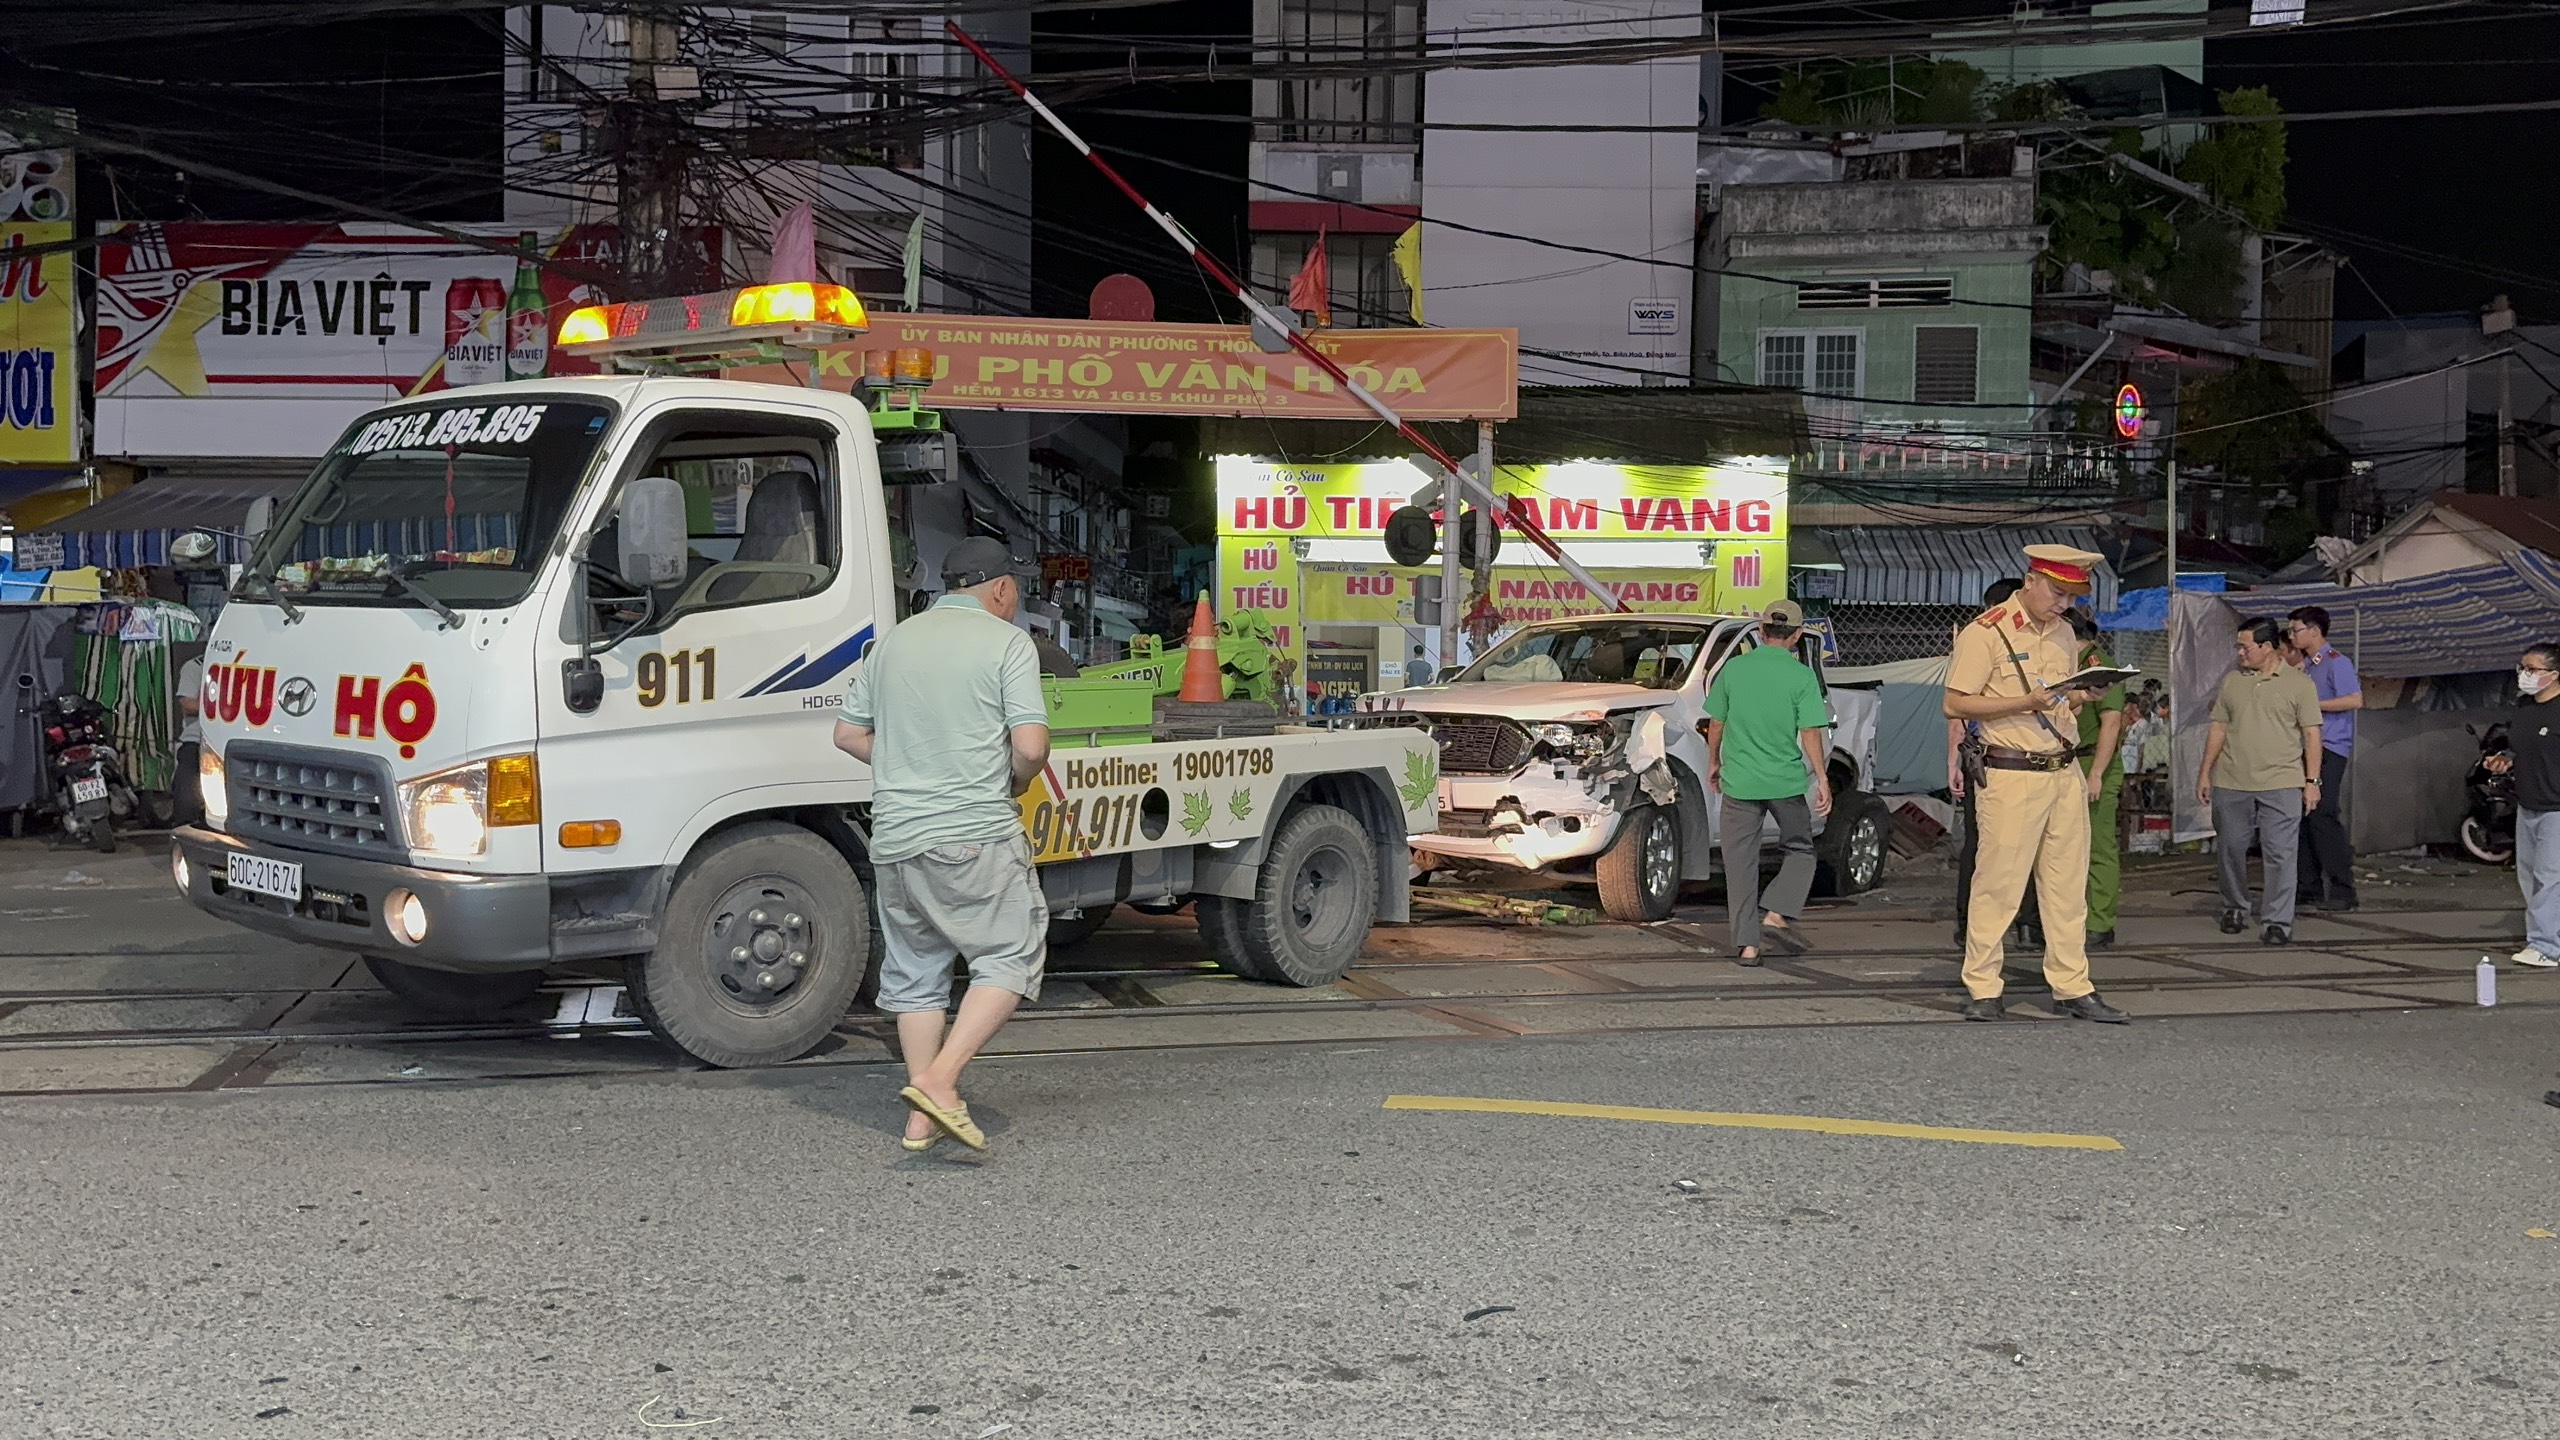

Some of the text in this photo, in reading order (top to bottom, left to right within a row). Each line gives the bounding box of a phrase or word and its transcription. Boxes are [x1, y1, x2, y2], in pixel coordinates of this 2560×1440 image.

[902, 325, 929, 342] ỦY
[938, 329, 982, 344] BAN
[991, 329, 1049, 347] NHÂN
[1057, 332, 1101, 349] DÂN
[1110, 335, 1198, 351] PHƯỜNG
[1206, 334, 1263, 353] THỐN
[978, 351, 1121, 387] PHỐ
[1136, 358, 1268, 391] VĂN
[1011, 386, 1064, 399] 1613
[1072, 384, 1100, 400] VÀ
[1110, 390, 1163, 402] 1615
[1171, 392, 1218, 404] KHU
[1223, 388, 1269, 405] PHỐ
[1275, 394, 1289, 405] 3
[1234, 484, 1307, 530] HỦ
[1619, 497, 1771, 533] VANG
[1243, 541, 1279, 571] HỦ
[1733, 549, 1761, 587] MÌ
[1233, 579, 1289, 609] TIẾU
[1346, 570, 1395, 596] HỦ
[1499, 579, 1587, 602] NAM
[637, 645, 717, 709] 911
[202, 649, 438, 760] CỨU HỘ
[802, 694, 843, 709] HD65
[1066, 747, 1274, 790] Hotline: 19001798
